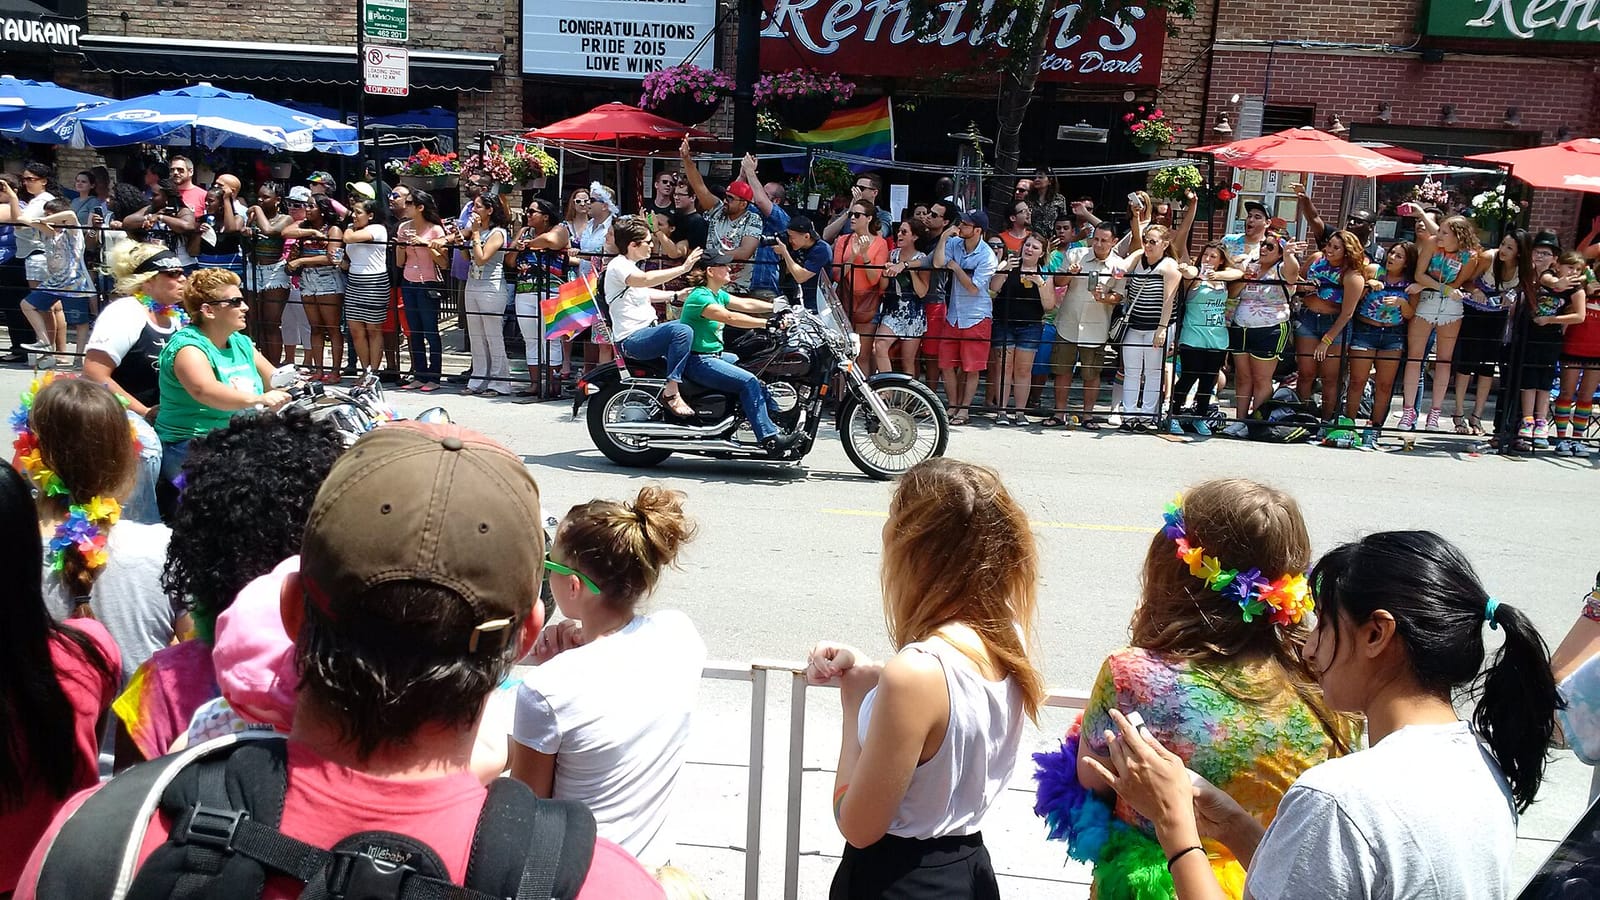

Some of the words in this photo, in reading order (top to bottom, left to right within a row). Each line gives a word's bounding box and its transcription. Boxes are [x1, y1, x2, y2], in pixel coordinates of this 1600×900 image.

[559, 19, 695, 40] CONGRATULATIONS
[581, 38, 625, 54] PRIDE
[633, 41, 666, 56] 2015
[586, 56, 620, 72] LOVE
[627, 57, 663, 73] WINS
[1040, 53, 1075, 71] ter
[1079, 51, 1143, 74] Dark
[367, 85, 383, 93] TOW
[386, 87, 404, 95] ZONE
